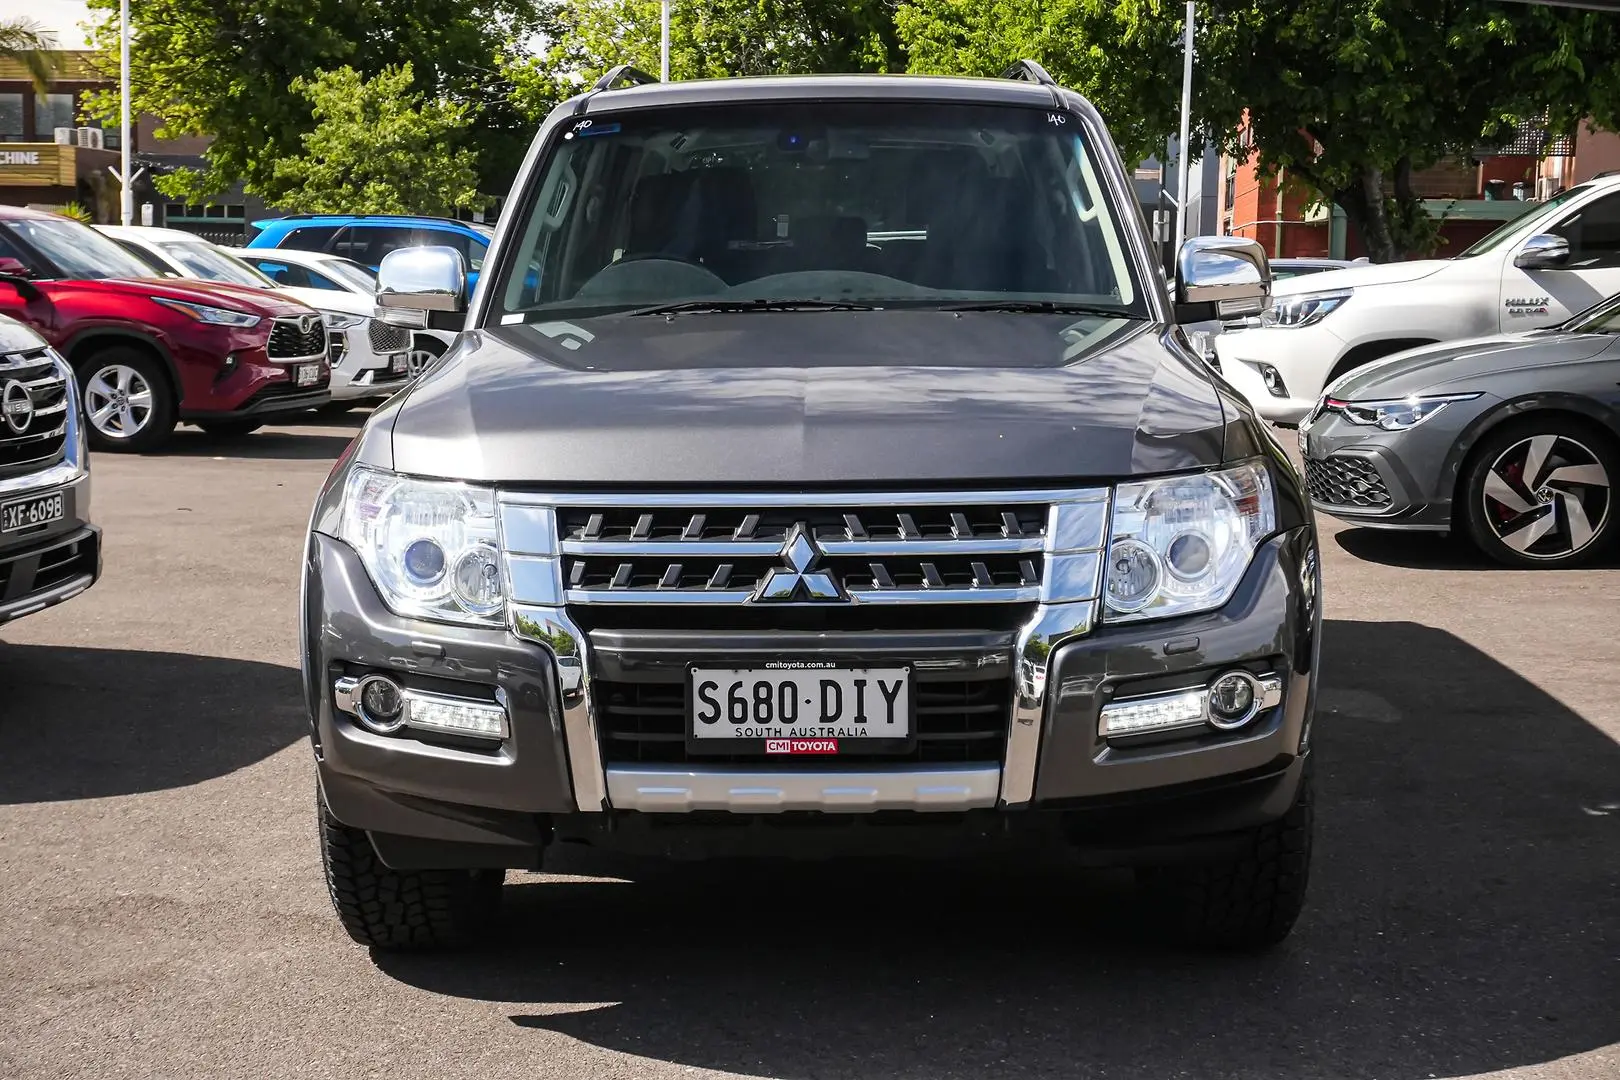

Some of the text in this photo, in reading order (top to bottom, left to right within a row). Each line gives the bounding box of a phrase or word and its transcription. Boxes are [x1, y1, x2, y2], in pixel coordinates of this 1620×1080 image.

[765, 660, 836, 670] cmitoyota.com.au
[735, 727, 868, 737] SOUTH AUSTRALIA
[768, 741, 836, 751] CMI TOYOTA
